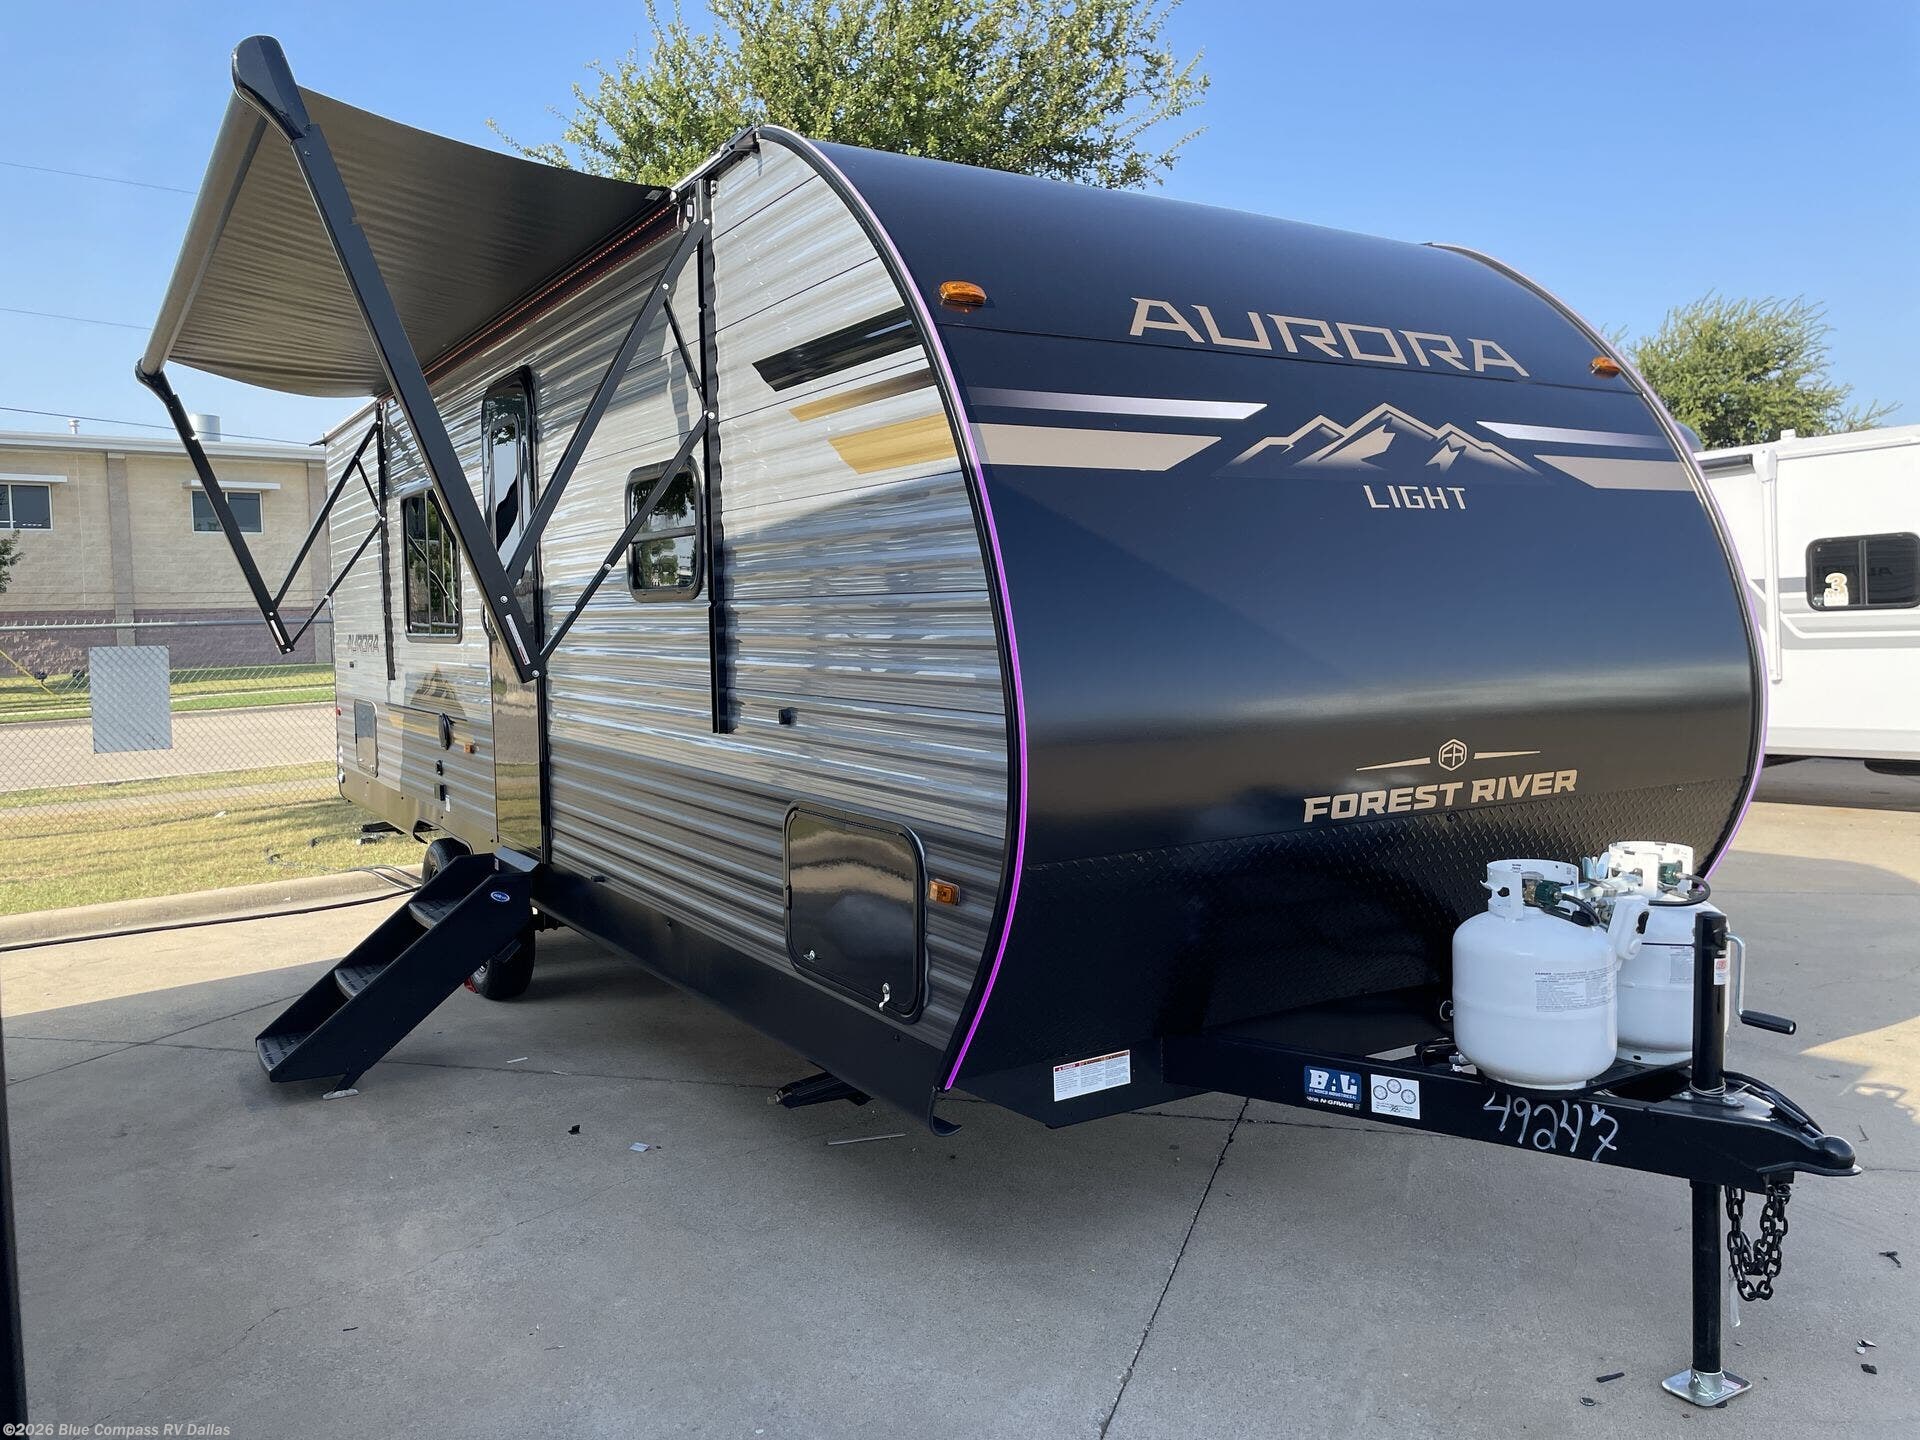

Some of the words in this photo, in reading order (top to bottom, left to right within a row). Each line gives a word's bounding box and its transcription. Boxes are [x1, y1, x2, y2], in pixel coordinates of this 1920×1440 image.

[1130, 297, 1530, 377] AURORA
[1363, 485, 1466, 510] LIGHT
[1303, 781, 1464, 823] FOREST
[1470, 769, 1578, 804] RIVER
[1309, 1069, 1358, 1095] BAL
